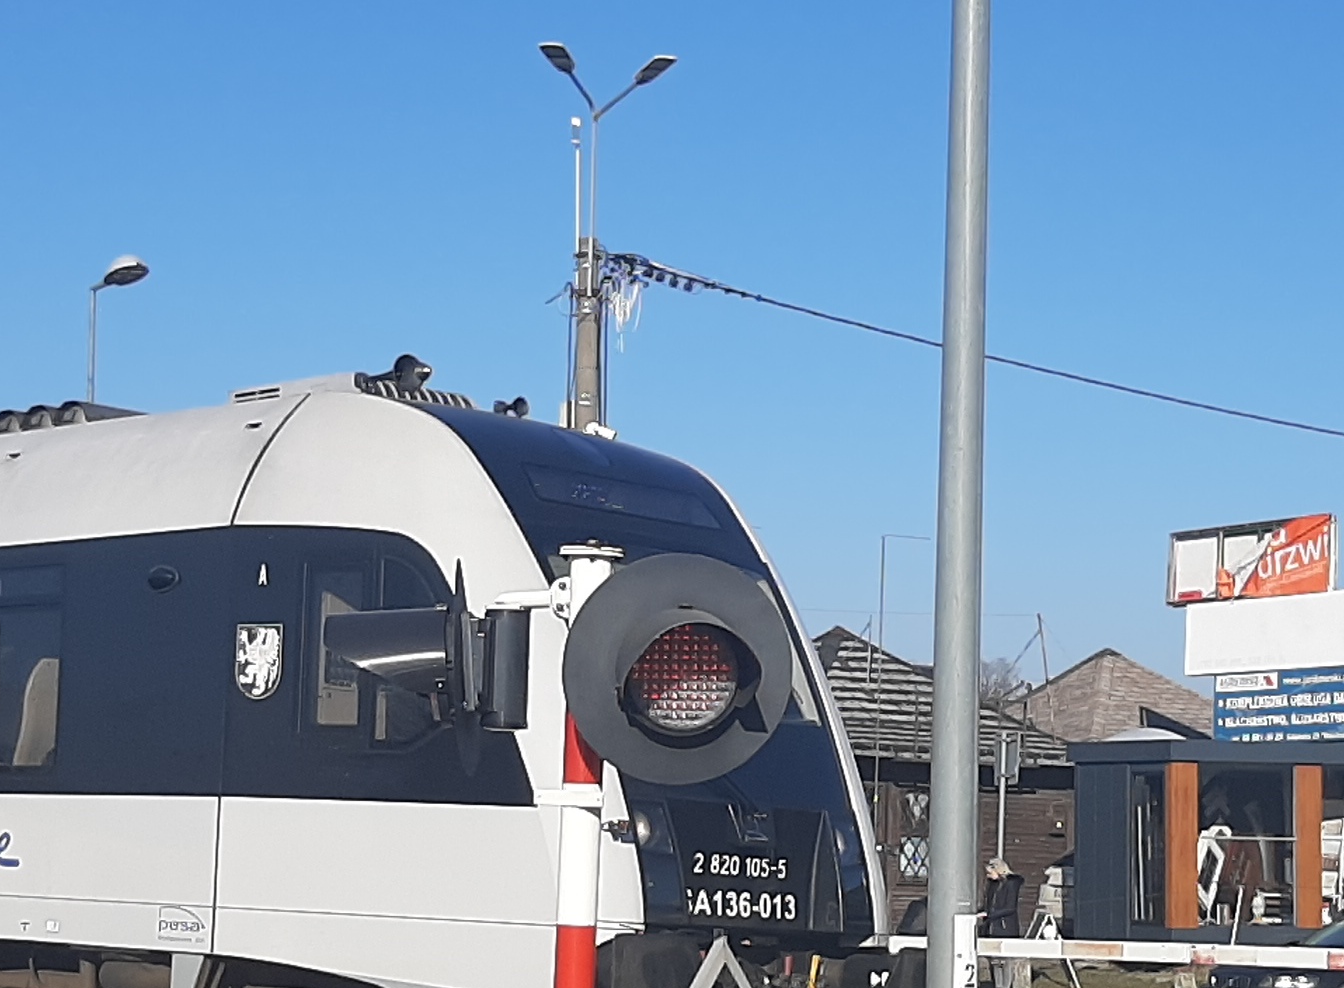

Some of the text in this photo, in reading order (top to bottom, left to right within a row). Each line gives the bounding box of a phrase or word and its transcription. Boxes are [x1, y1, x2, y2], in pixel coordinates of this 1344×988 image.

[258, 563, 268, 586] A
[693, 852, 787, 879] 2 820 105-5
